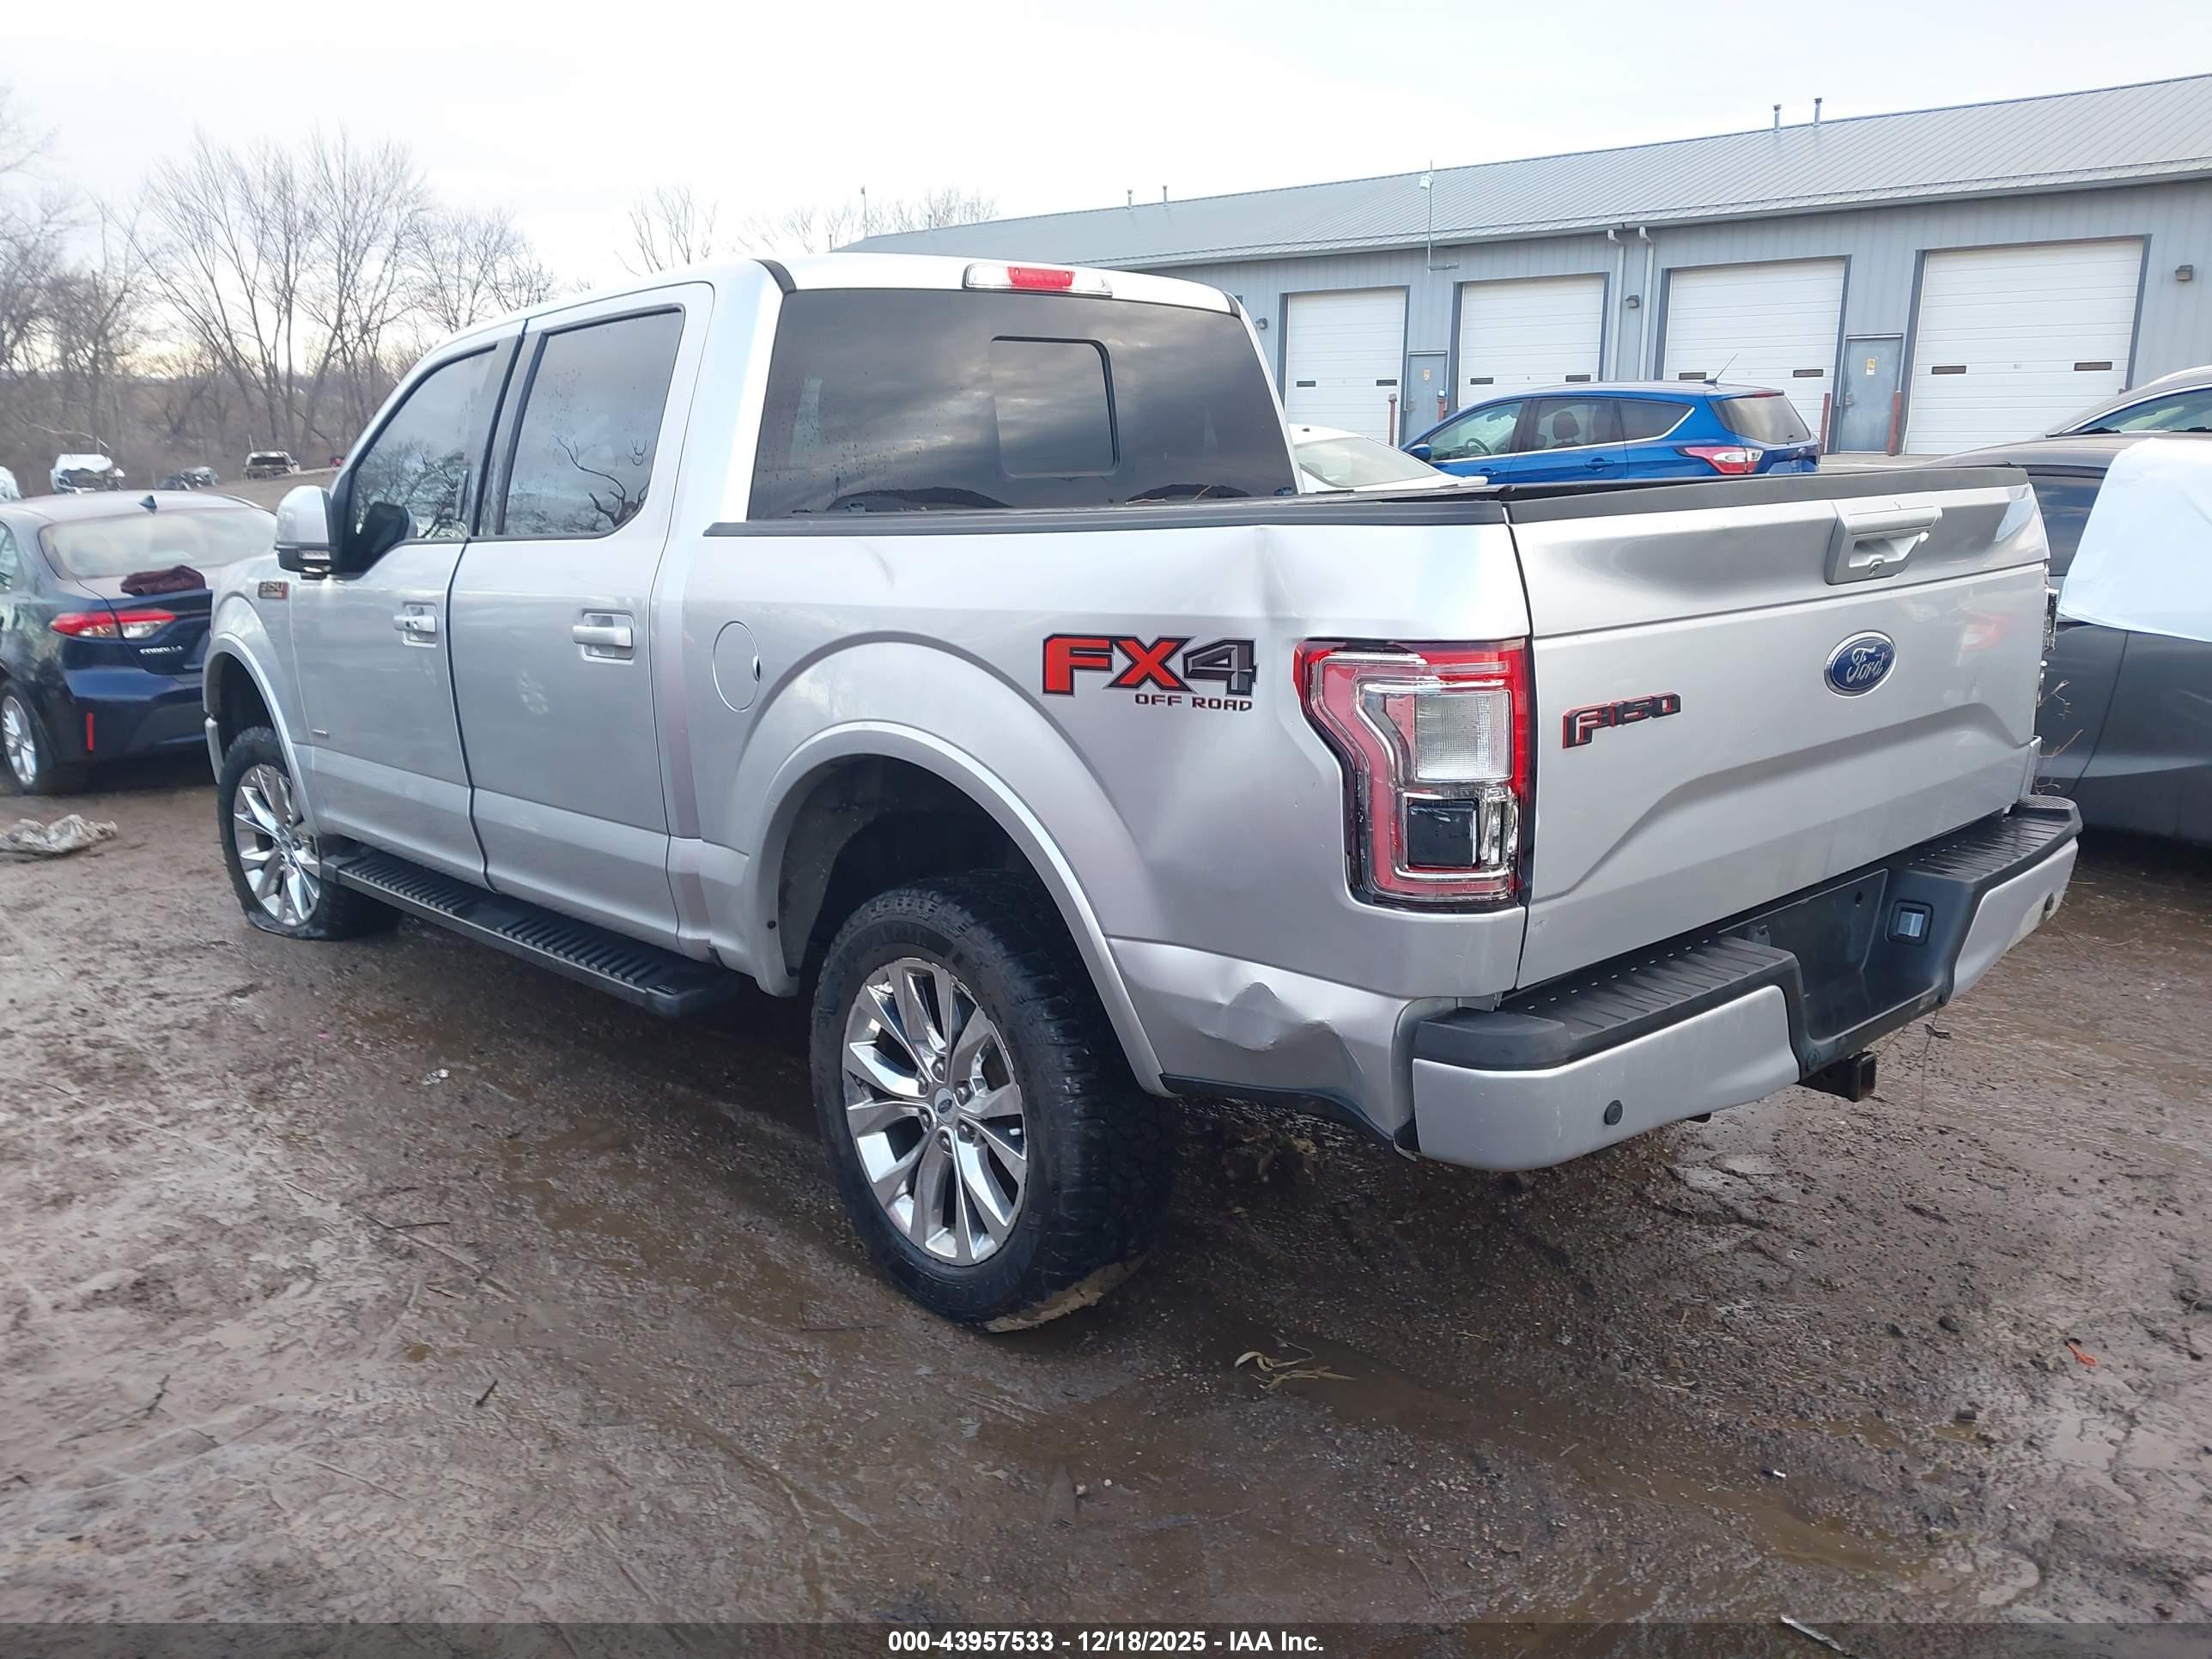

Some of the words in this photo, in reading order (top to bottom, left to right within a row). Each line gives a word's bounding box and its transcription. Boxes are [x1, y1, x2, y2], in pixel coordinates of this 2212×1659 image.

[1042, 634, 1257, 695] FX4
[1134, 693, 1182, 707] OFF
[1192, 696, 1253, 712] ROAD
[1563, 690, 1682, 749] F150
